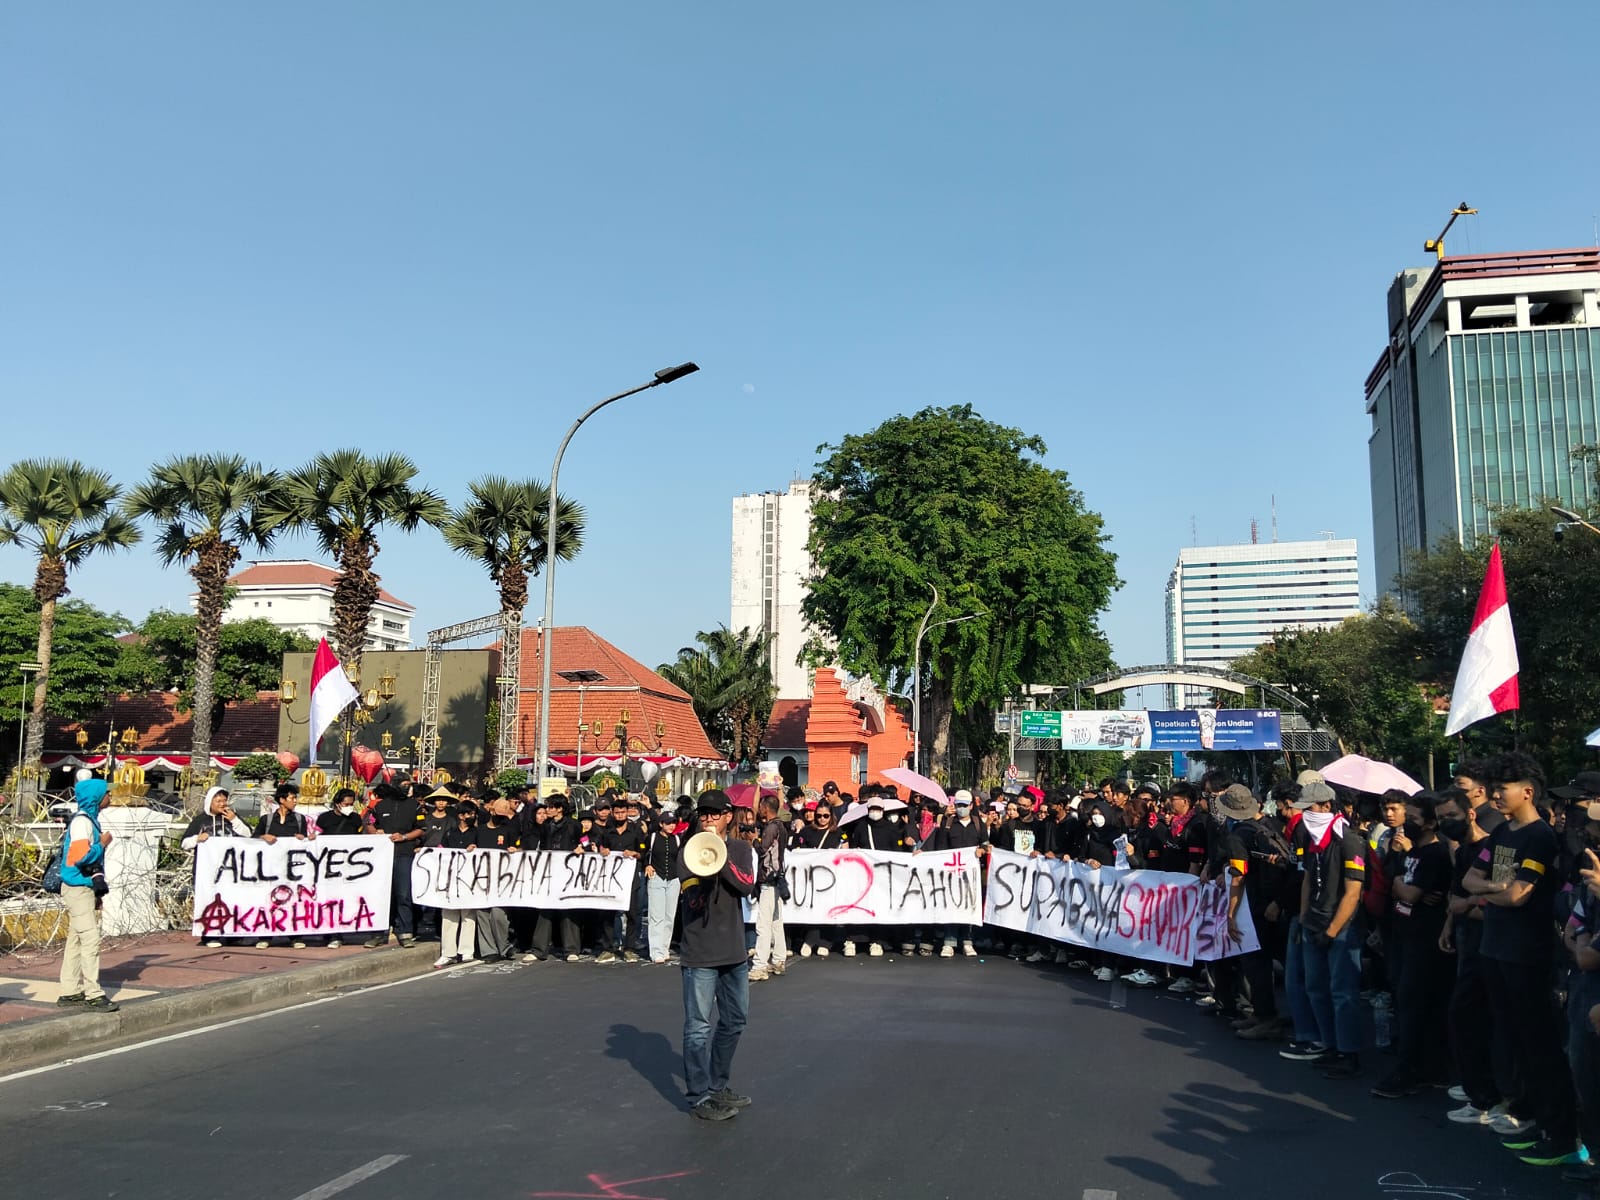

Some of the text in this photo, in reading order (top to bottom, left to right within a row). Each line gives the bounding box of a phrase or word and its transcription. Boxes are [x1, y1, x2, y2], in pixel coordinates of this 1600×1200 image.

[1154, 720, 1190, 728] Dapatkan
[1227, 719, 1254, 727] Undian
[214, 846, 375, 885] ALL EYES
[271, 884, 317, 905] ON
[827, 852, 877, 919] 2
[873, 860, 978, 911] TAHUN
